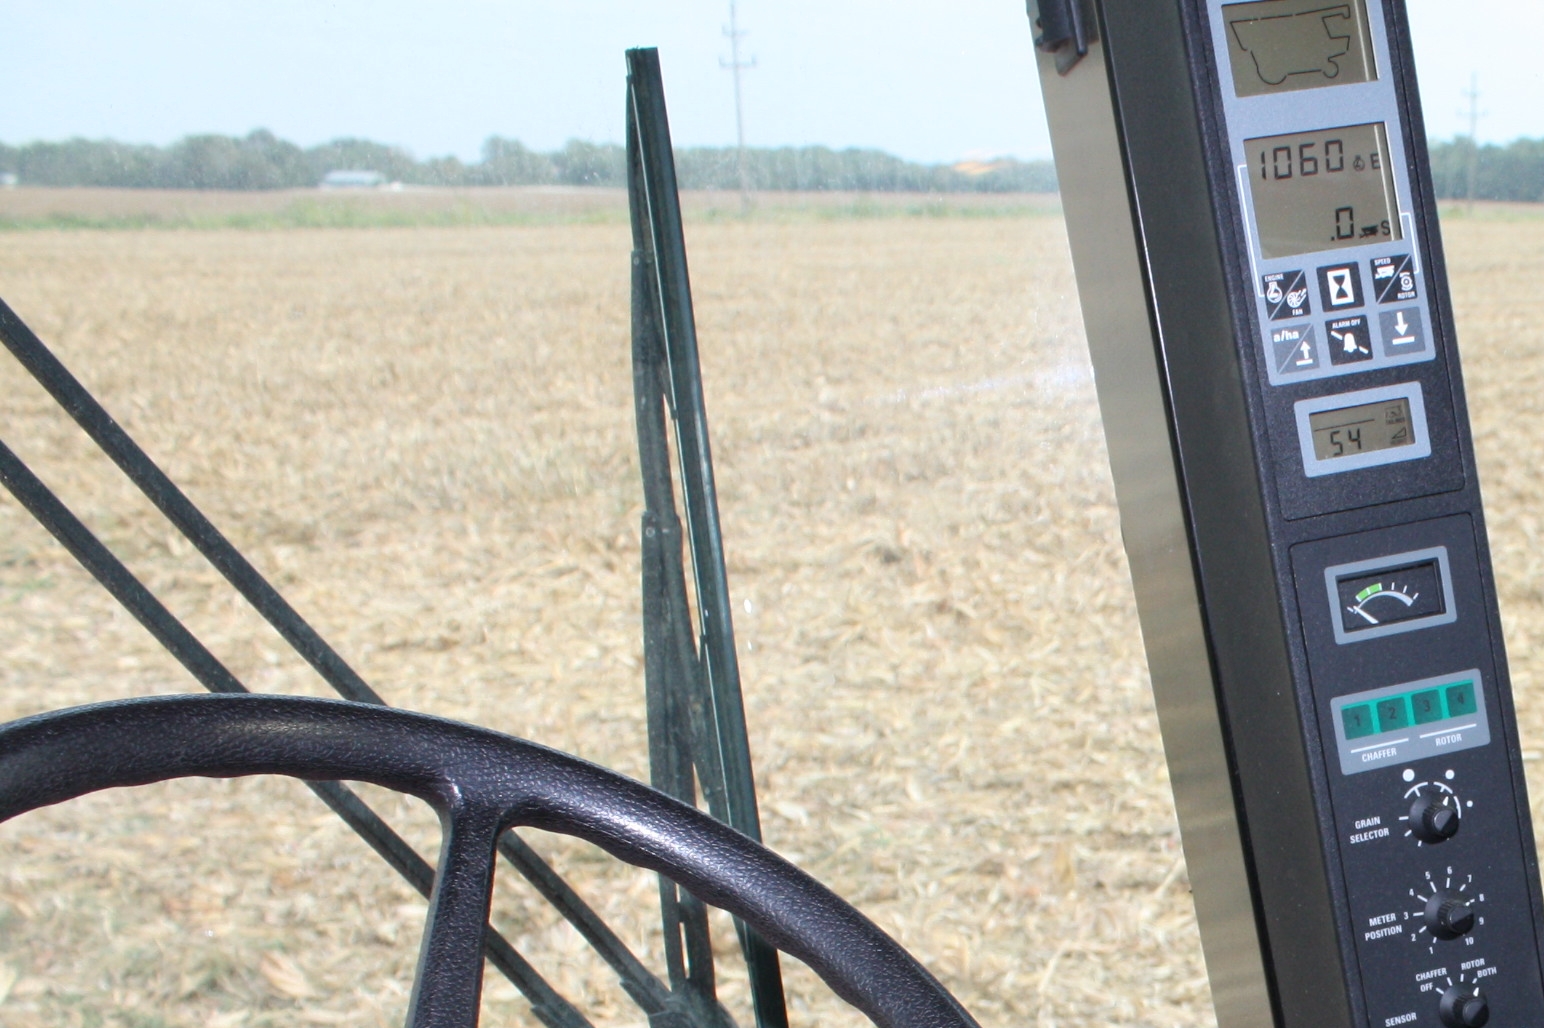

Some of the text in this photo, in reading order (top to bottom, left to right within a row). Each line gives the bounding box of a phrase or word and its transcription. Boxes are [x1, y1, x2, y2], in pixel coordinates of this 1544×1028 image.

[1261, 139, 1344, 180] 1060
[1374, 256, 1391, 266] SPEED
[1264, 273, 1285, 282] ENGINE
[1397, 290, 1416, 300] ROTOR
[1292, 308, 1304, 316] FAN
[1332, 318, 1362, 329] ALARM OFF
[1273, 329, 1299, 343] a/ha
[1330, 428, 1362, 456] 54
[1353, 715, 1362, 727] 1
[1388, 707, 1398, 720] 2
[1423, 699, 1431, 712] 3
[1435, 733, 1463, 747] ROTOR
[1361, 747, 1397, 763] CHAFFER
[1354, 816, 1381, 830] GRAIN
[1349, 827, 1390, 845] SELECTOR
[1425, 871, 1431, 880] 5
[1446, 866, 1453, 875] 6
[1467, 874, 1473, 883] 7
[1408, 888, 1414, 897] 4
[1479, 893, 1485, 902] 8
[1368, 912, 1397, 927] METER
[1403, 911, 1409, 920] 3
[1478, 917, 1485, 925] 9
[1364, 924, 1403, 942] POSITION
[1411, 933, 1417, 942] 2
[1464, 936, 1474, 946] 10
[1429, 946, 1434, 955] 1
[1460, 958, 1486, 971] ROTOR
[1415, 967, 1447, 982] CHAFFER
[1476, 966, 1497, 979] BOTH
[1420, 982, 1434, 993] OFF
[1385, 1012, 1417, 1028] SENSOR
